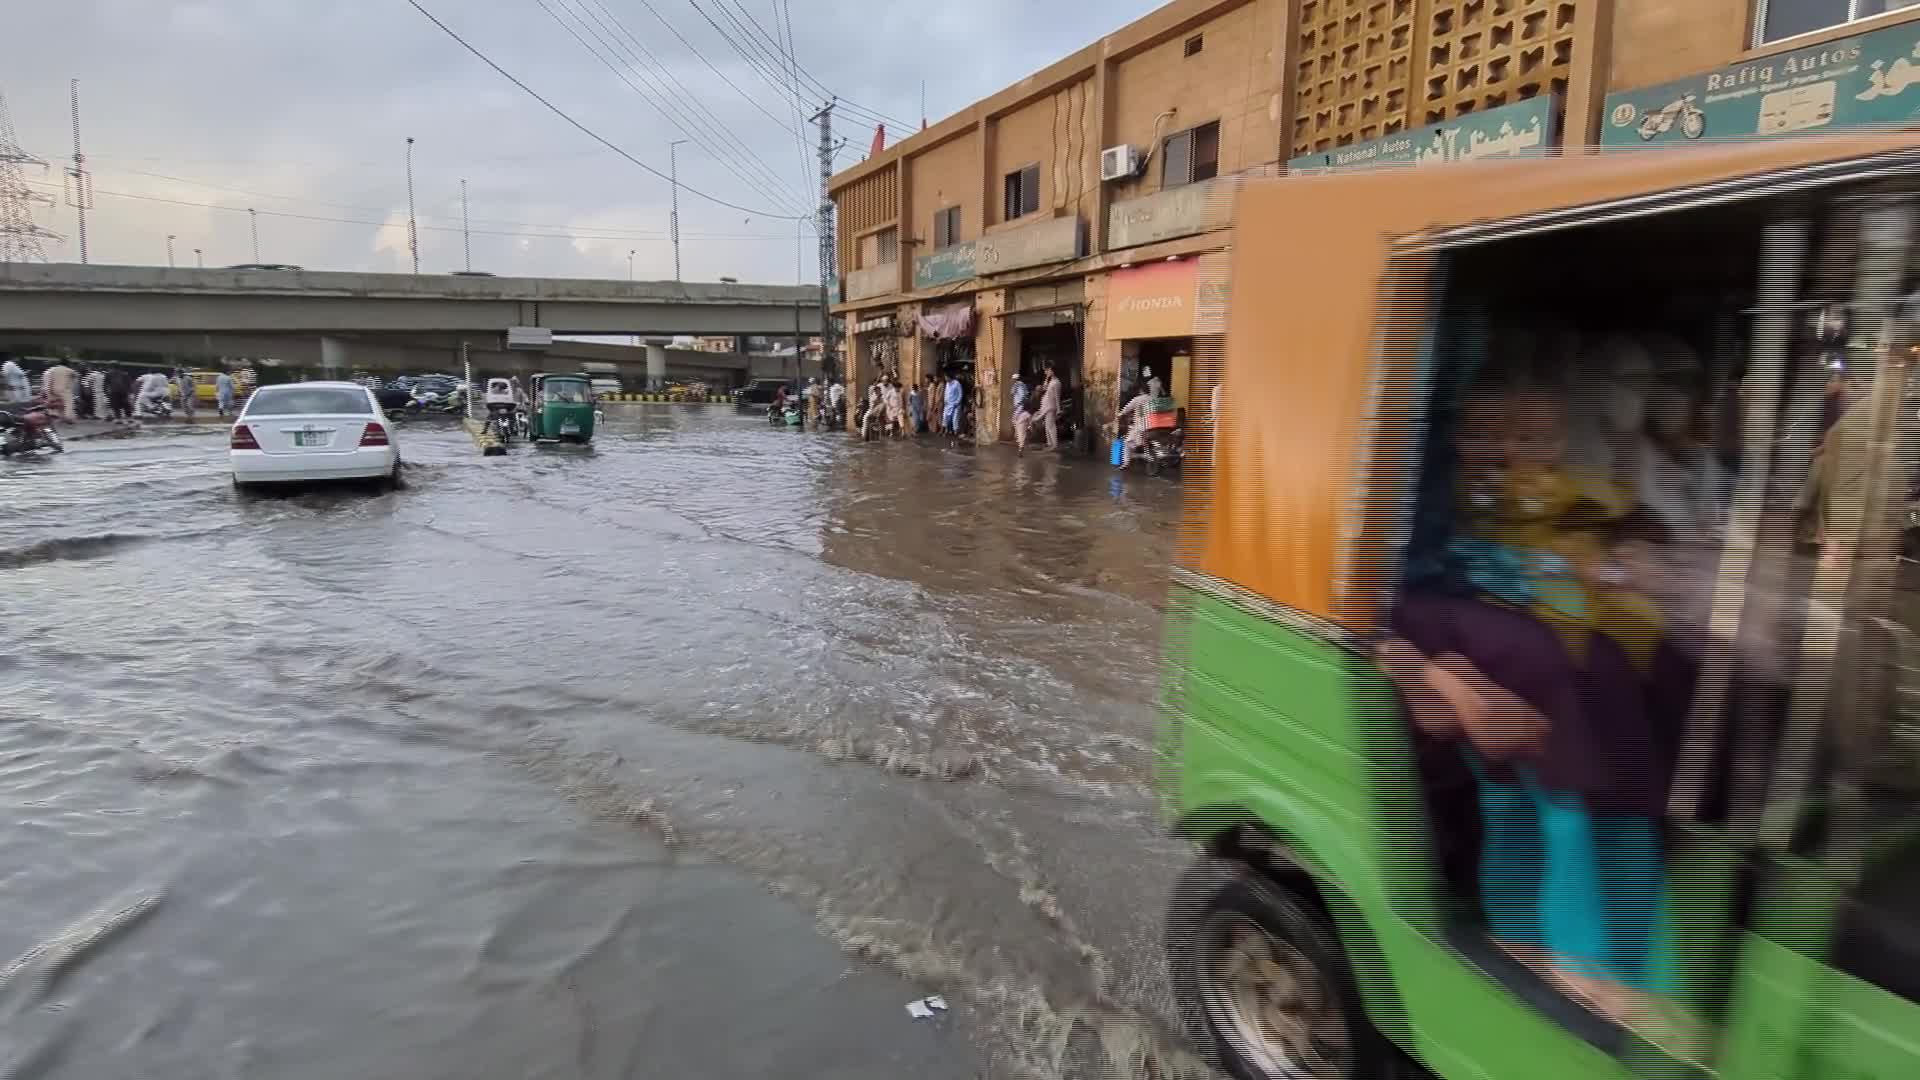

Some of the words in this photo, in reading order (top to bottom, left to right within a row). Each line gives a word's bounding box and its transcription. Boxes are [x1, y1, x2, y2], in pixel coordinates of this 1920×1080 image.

[1706, 65, 1774, 91] Rafiq
[1782, 46, 1861, 75] Autos
[1336, 144, 1378, 165] National
[1382, 139, 1411, 154] Autos
[1129, 295, 1182, 310] HONDA
